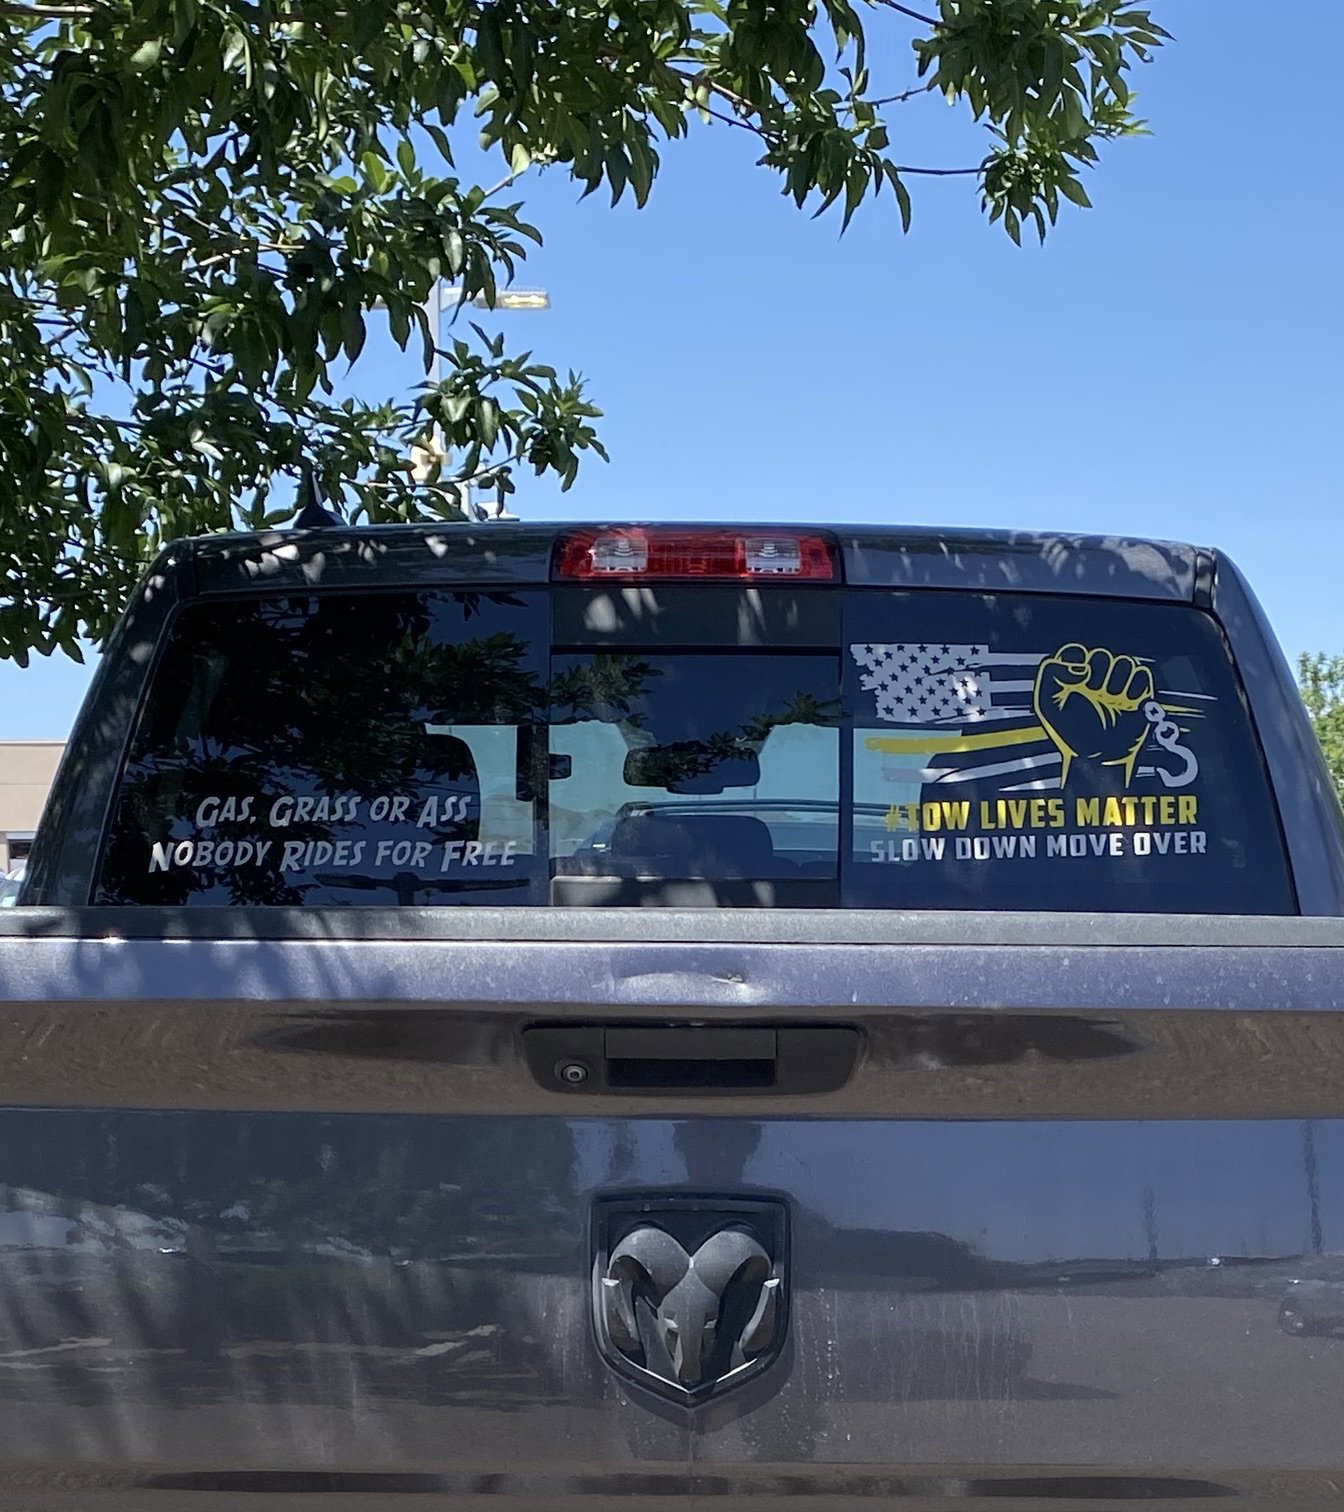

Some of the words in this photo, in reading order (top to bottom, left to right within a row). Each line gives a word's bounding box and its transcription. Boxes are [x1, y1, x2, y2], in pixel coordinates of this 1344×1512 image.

[884, 801, 970, 832] #TOW
[980, 798, 1065, 830] LIVES
[1076, 795, 1198, 827] MATTER
[870, 837, 946, 862] SLOW
[956, 836, 1037, 859] DOWN
[1046, 833, 1125, 857] MOVE
[1133, 830, 1207, 855] OVER
